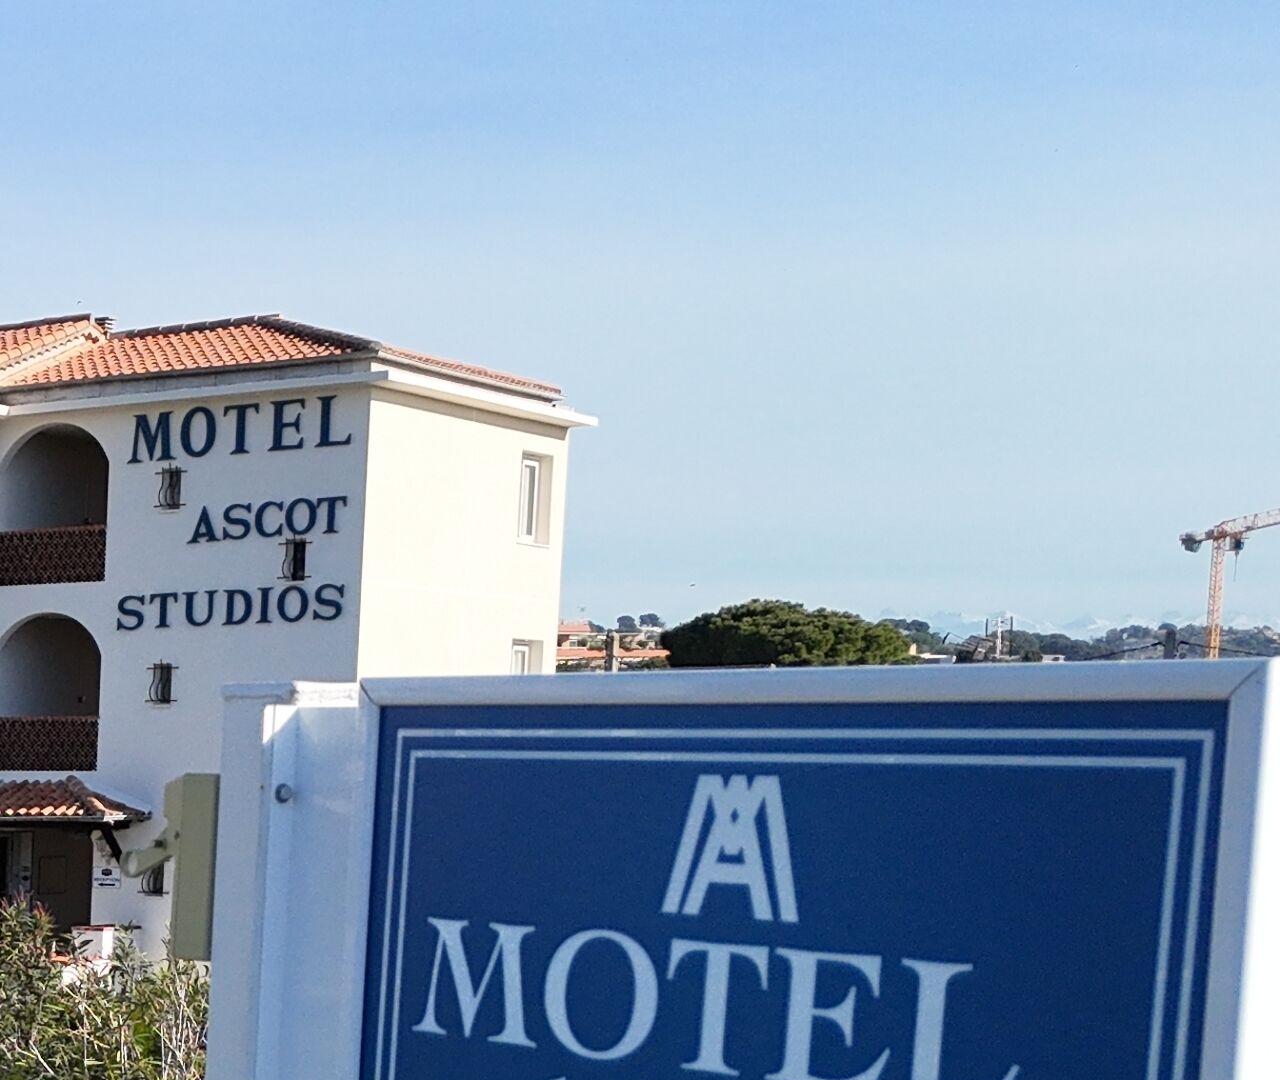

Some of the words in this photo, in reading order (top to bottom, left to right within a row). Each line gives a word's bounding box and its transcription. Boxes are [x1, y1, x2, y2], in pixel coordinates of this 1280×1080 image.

[127, 395, 352, 464] MOTEL
[187, 496, 347, 544] ASCOT
[116, 583, 345, 631] STUDIOS
